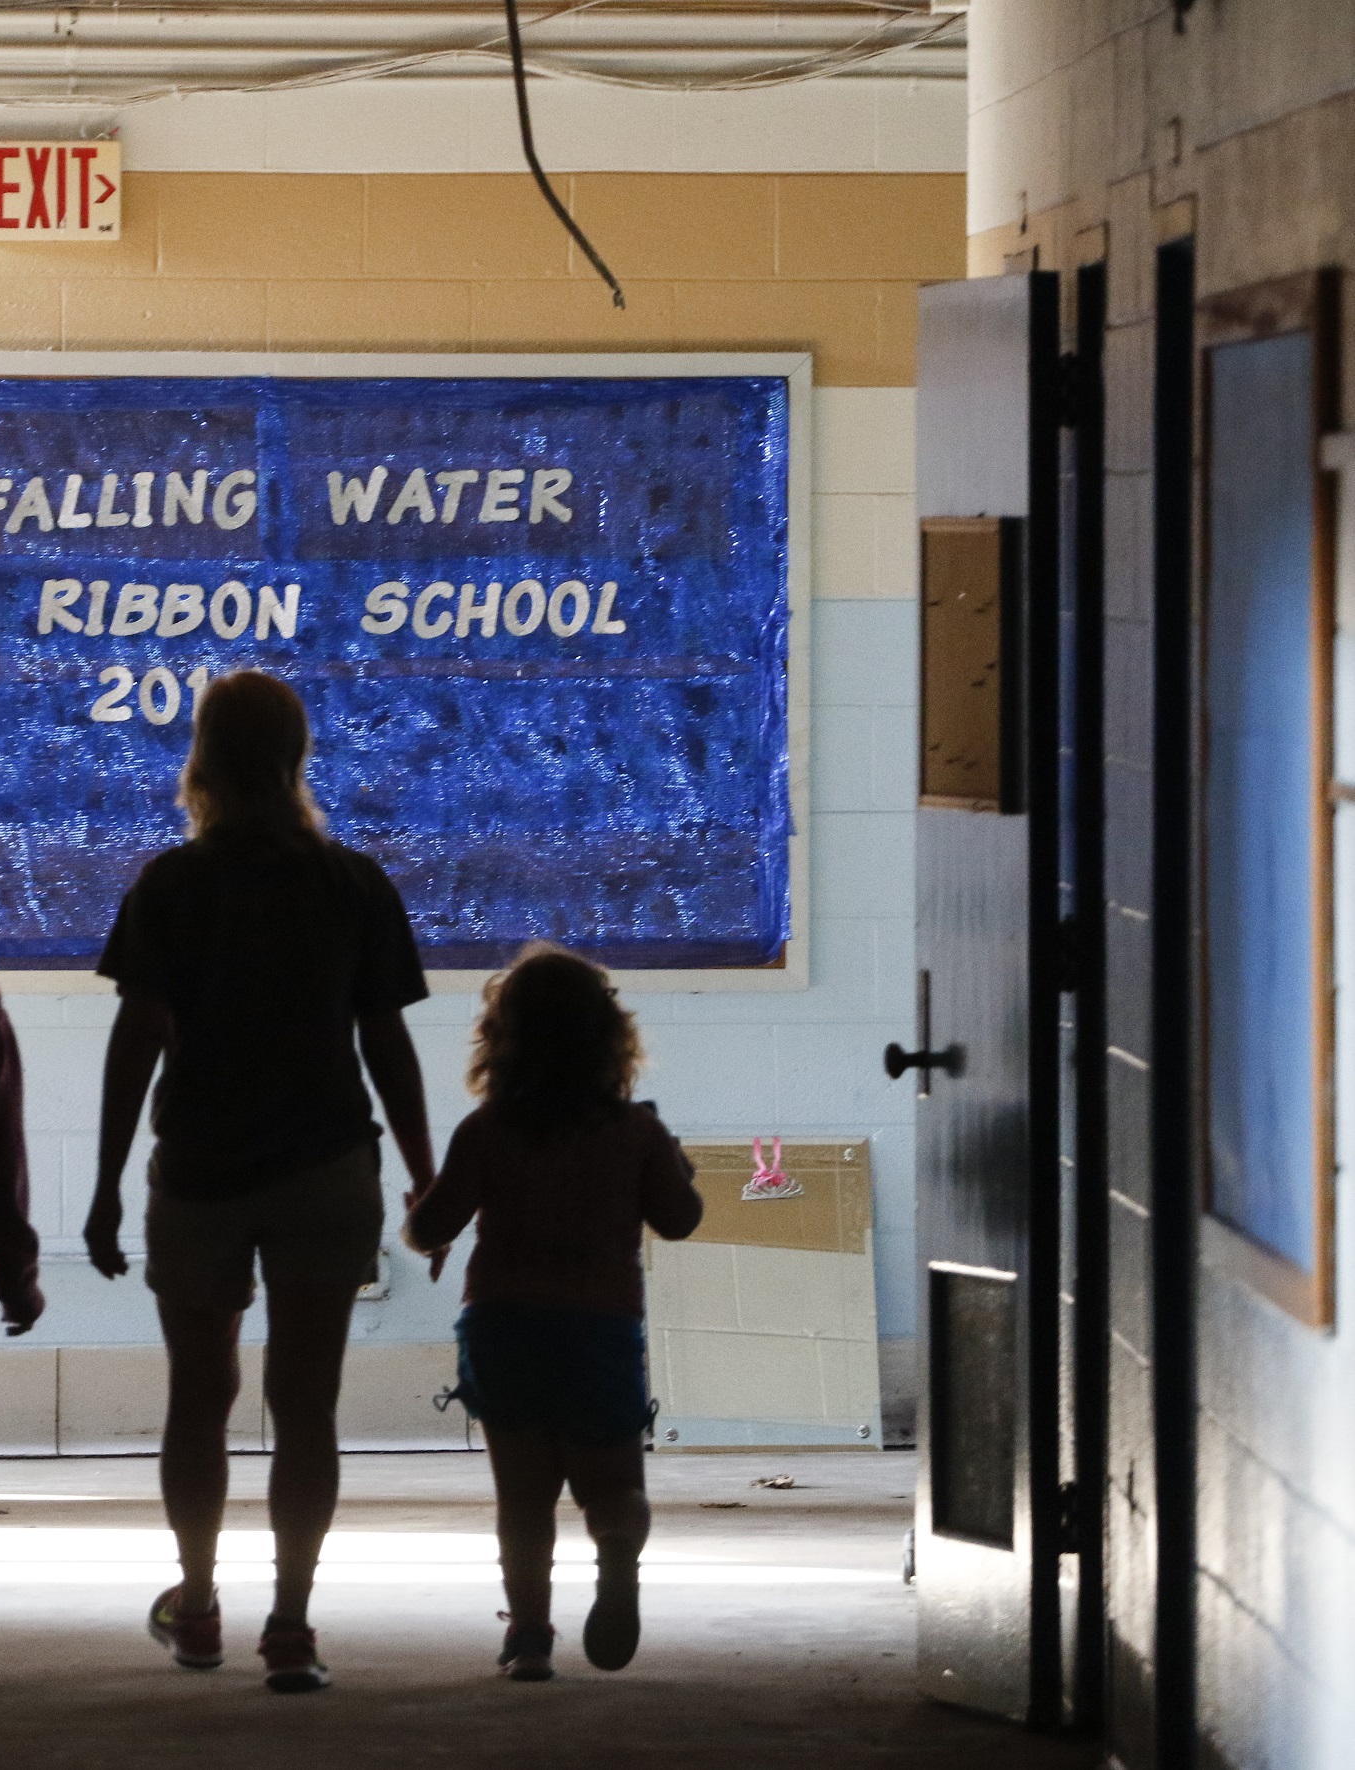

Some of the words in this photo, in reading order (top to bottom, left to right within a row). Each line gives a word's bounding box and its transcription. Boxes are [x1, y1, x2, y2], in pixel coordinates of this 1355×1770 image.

[327, 466, 572, 525] WATER
[37, 579, 300, 641] RIBBON
[361, 580, 626, 639] SCHOOL
[90, 665, 264, 726] 201
